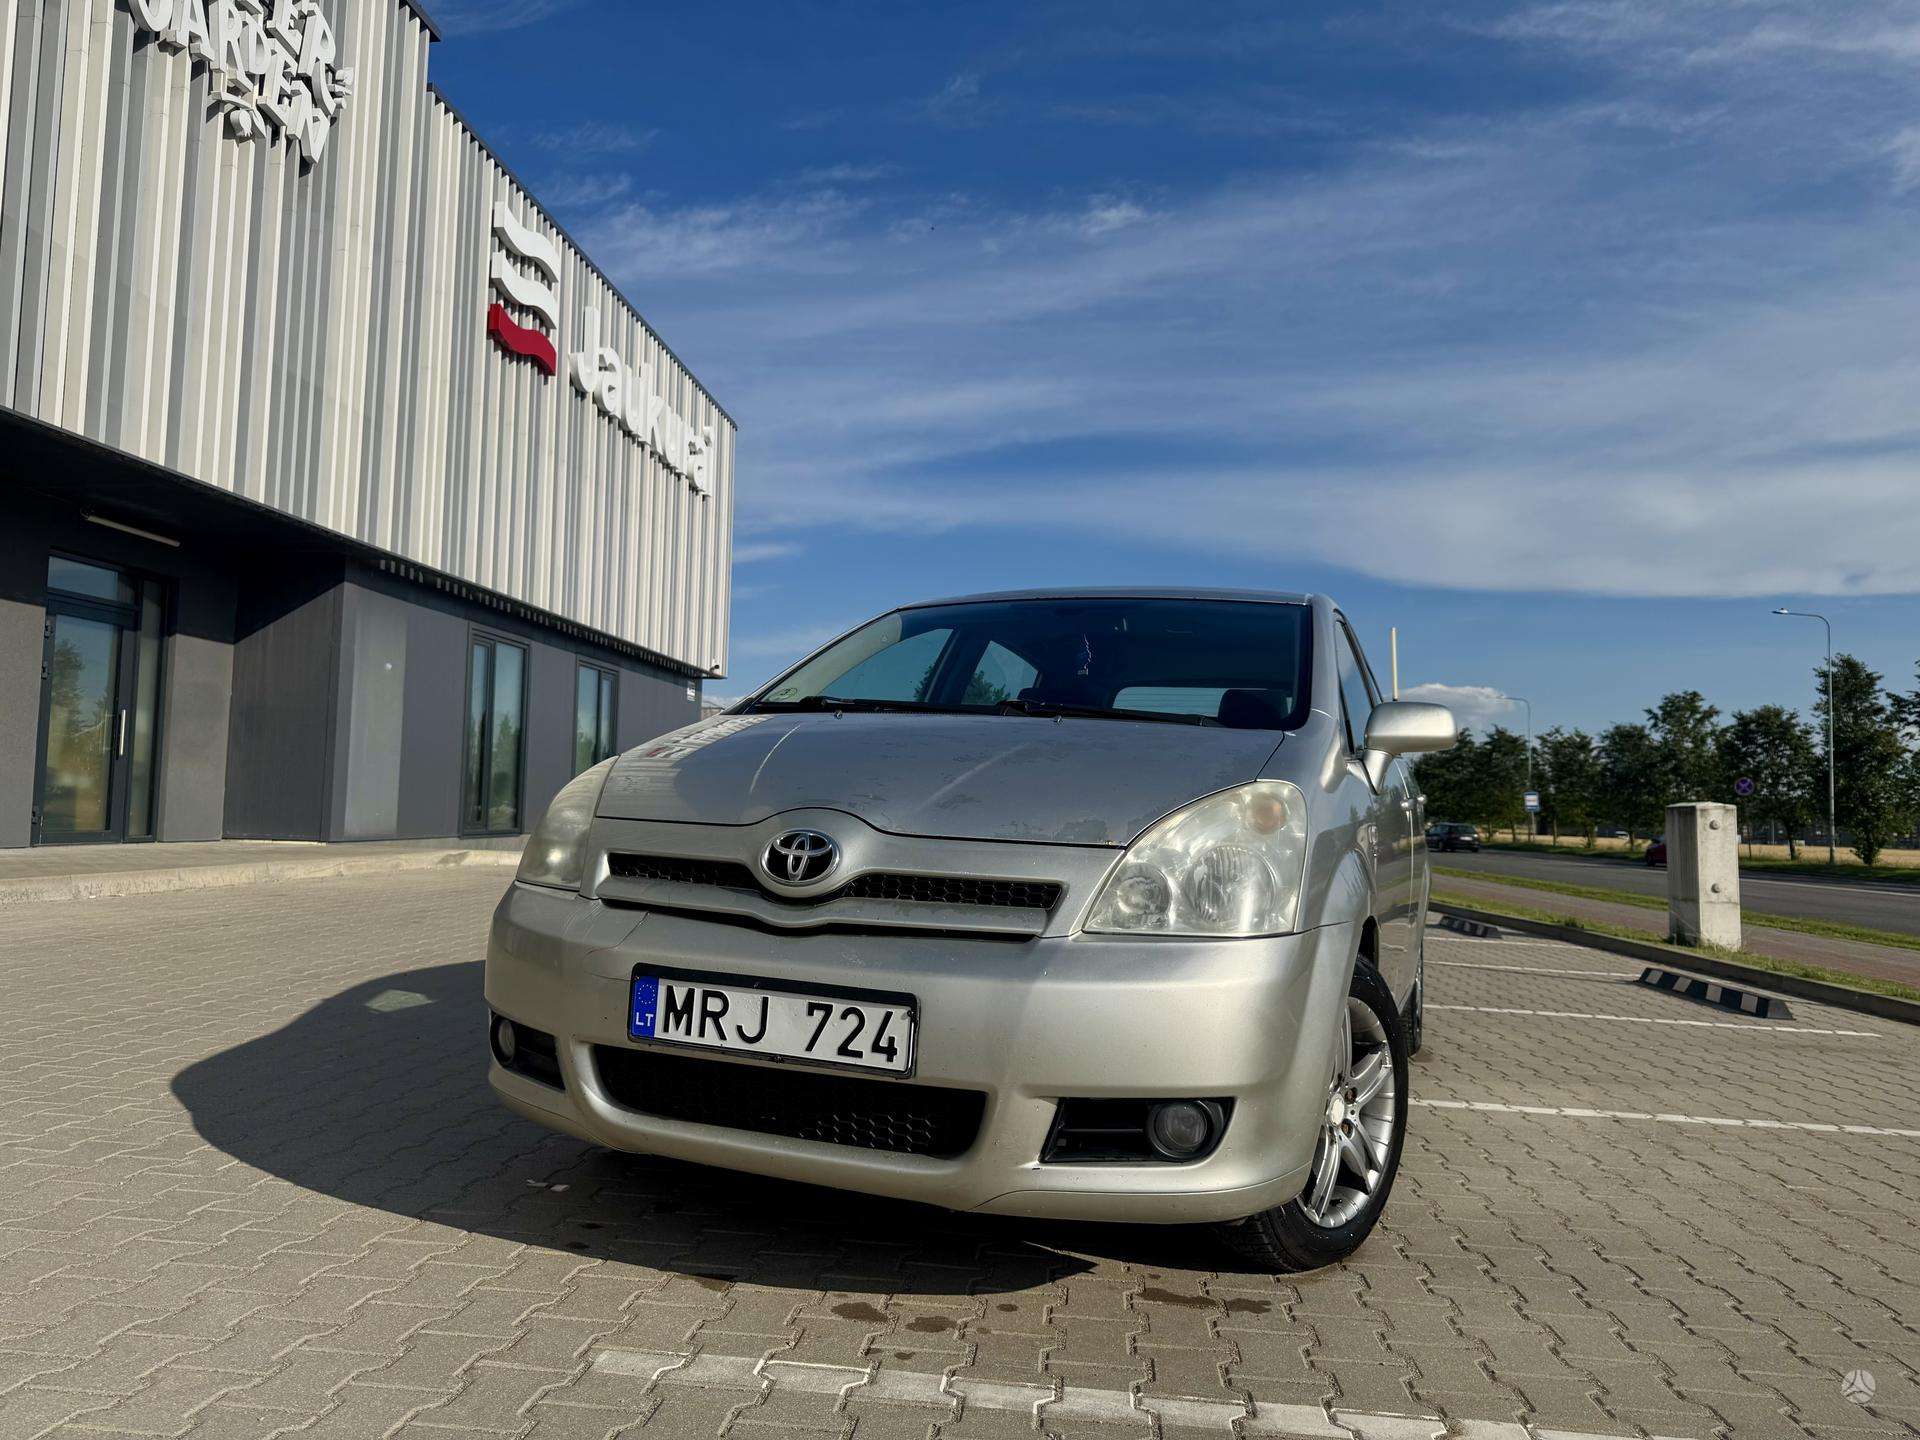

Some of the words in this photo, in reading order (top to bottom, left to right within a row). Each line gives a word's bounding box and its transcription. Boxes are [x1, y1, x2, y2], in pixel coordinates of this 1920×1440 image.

[569, 306, 714, 497] Jaukurai
[635, 1012, 654, 1027] LT
[663, 984, 769, 1044] MRJ
[805, 1001, 898, 1063] 724
